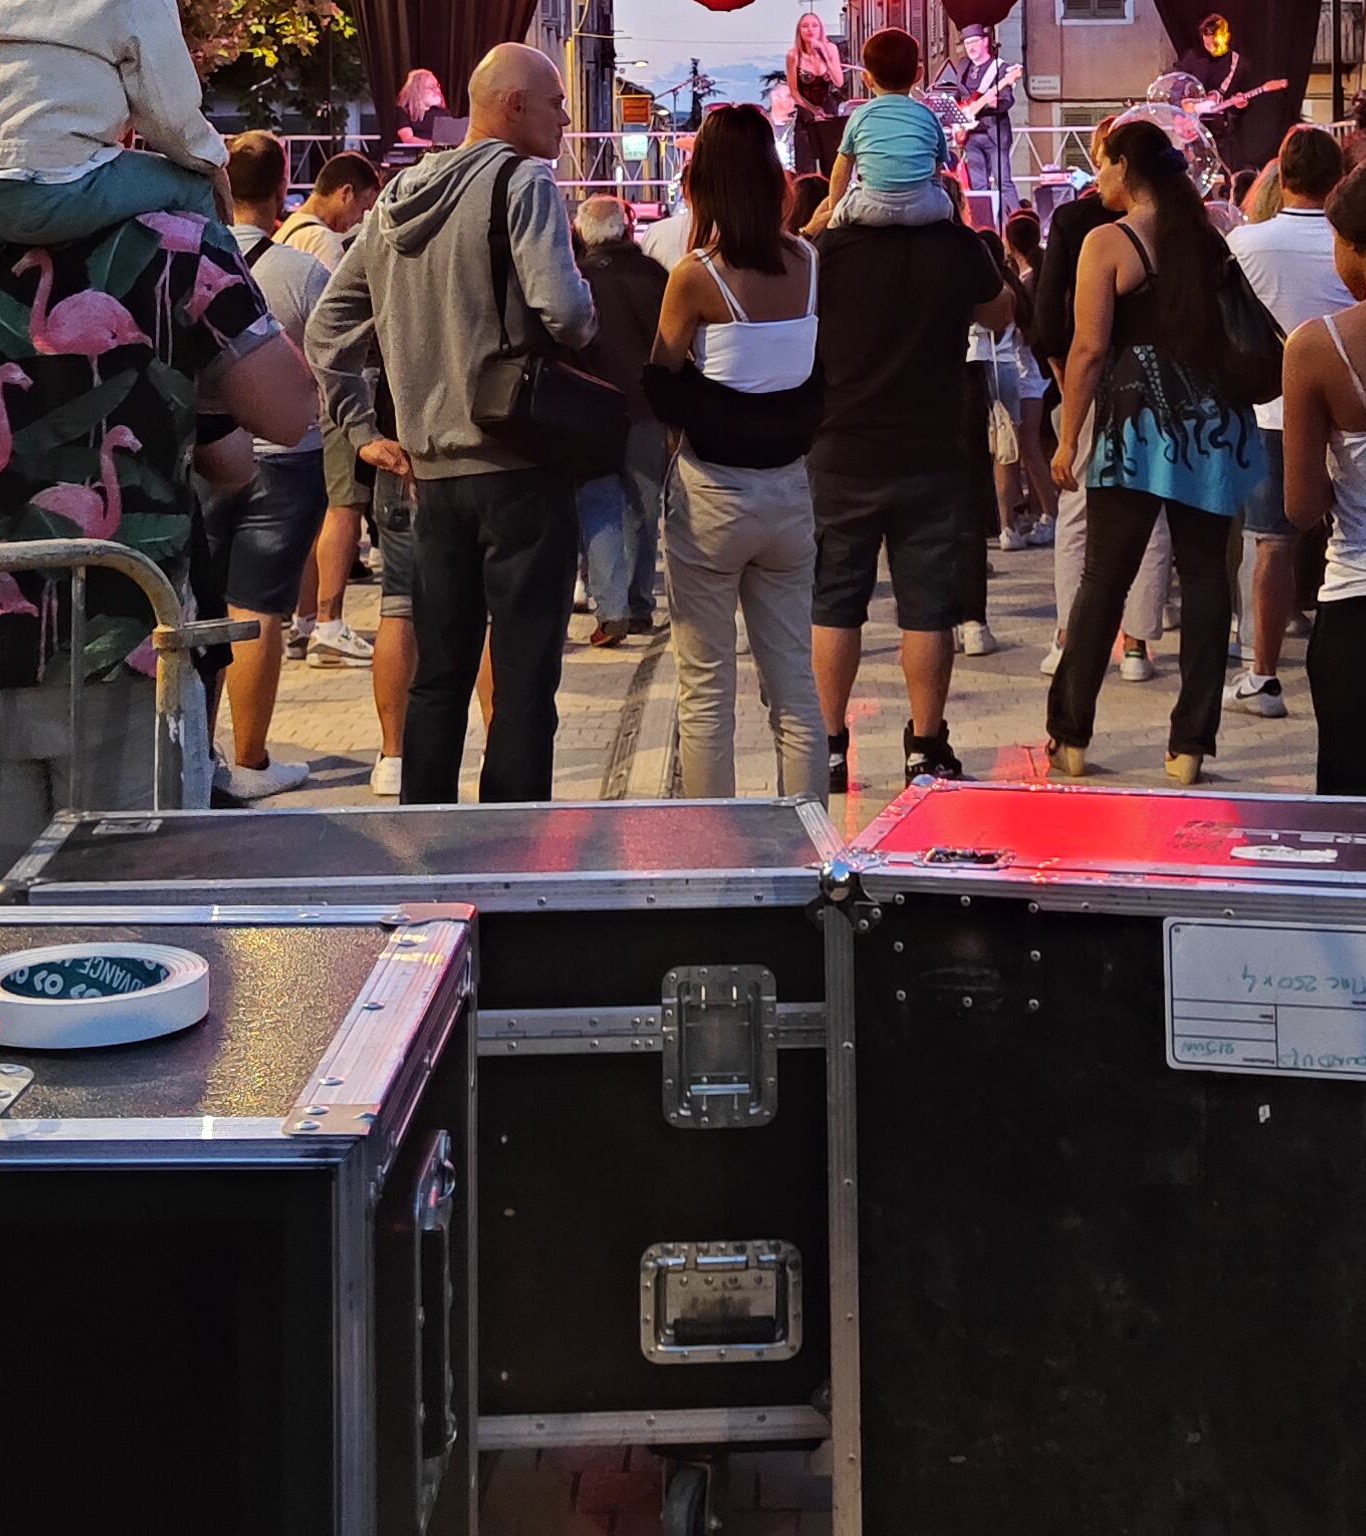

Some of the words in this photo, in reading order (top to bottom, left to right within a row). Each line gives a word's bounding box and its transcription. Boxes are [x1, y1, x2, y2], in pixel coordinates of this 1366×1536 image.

[76, 956, 145, 993] DVANCE
[1241, 964, 1256, 993] 4
[1277, 975, 1316, 990] 250
